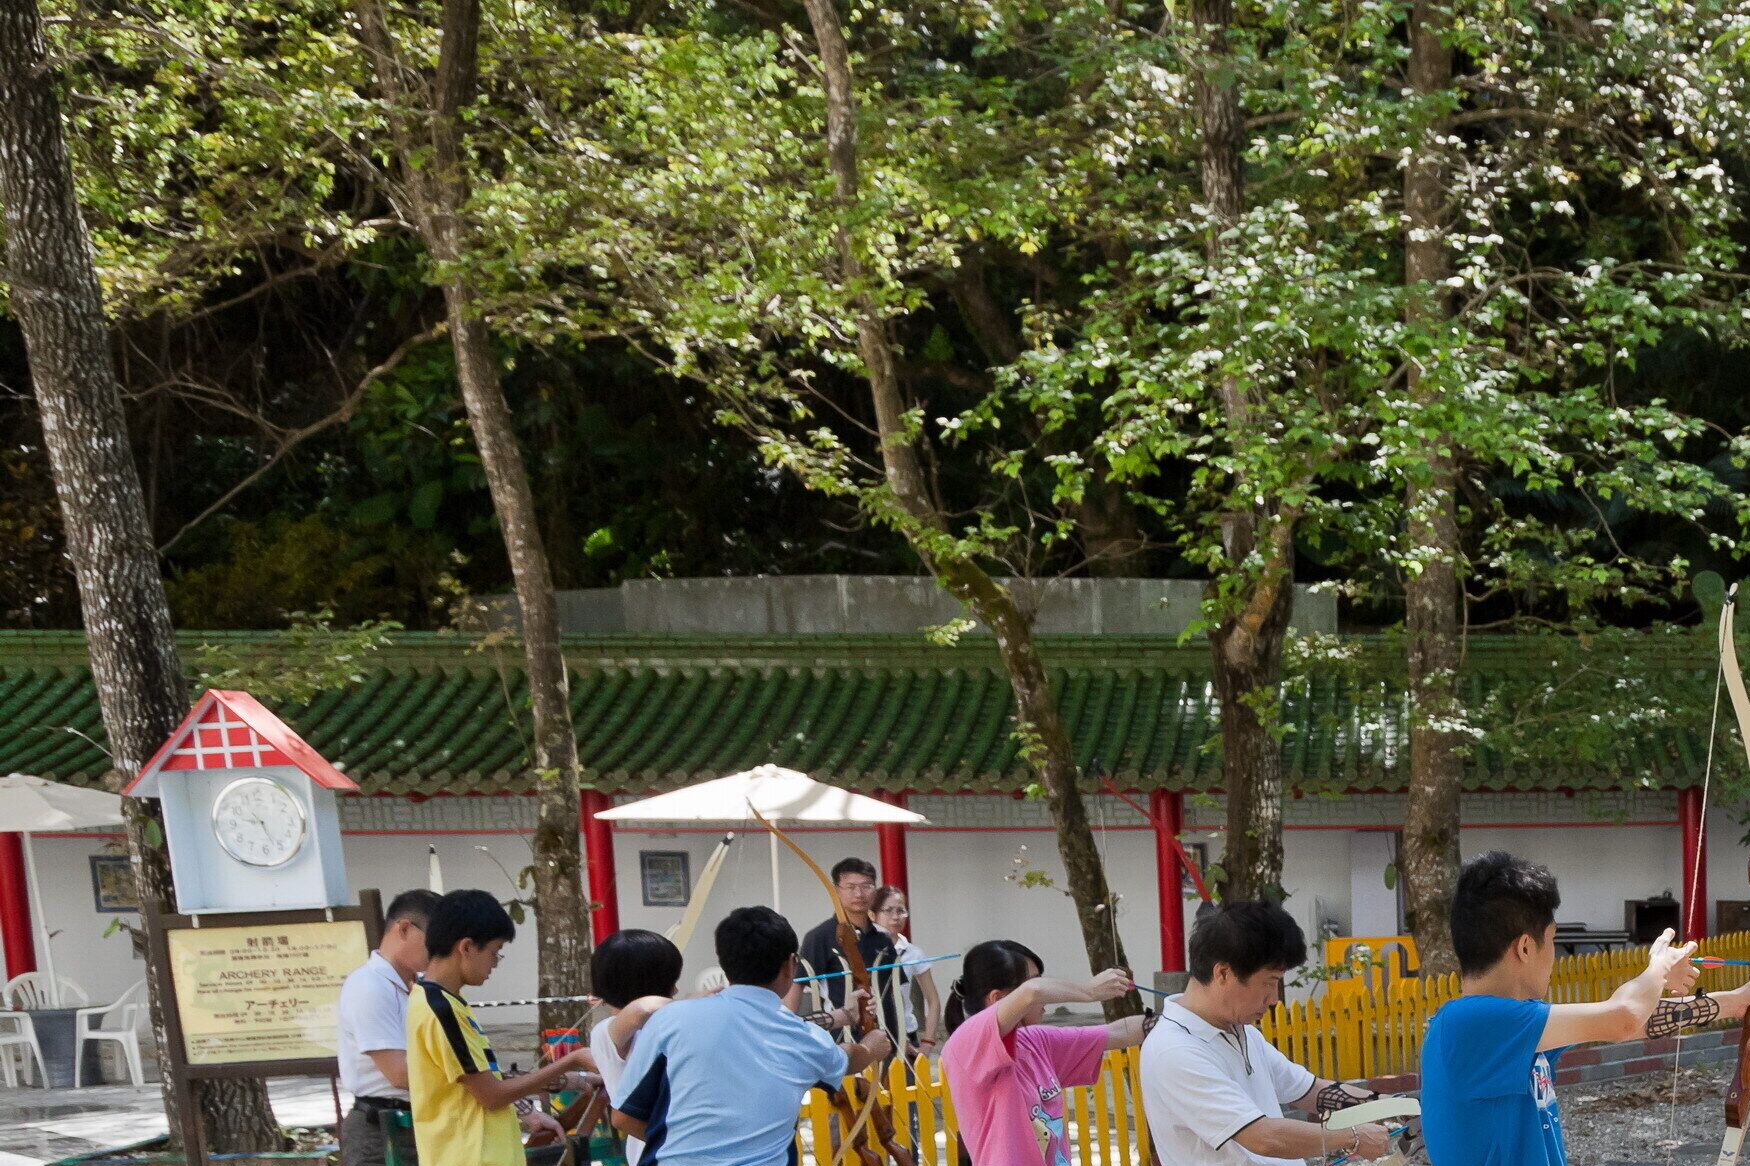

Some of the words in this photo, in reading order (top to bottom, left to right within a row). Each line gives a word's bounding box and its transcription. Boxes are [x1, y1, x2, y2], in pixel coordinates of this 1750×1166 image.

[262, 844, 270, 856] 6
[219, 969, 277, 980] ARCHERY
[283, 966, 327, 977] RANGE
[244, 996, 310, 1010] アーチェリー
